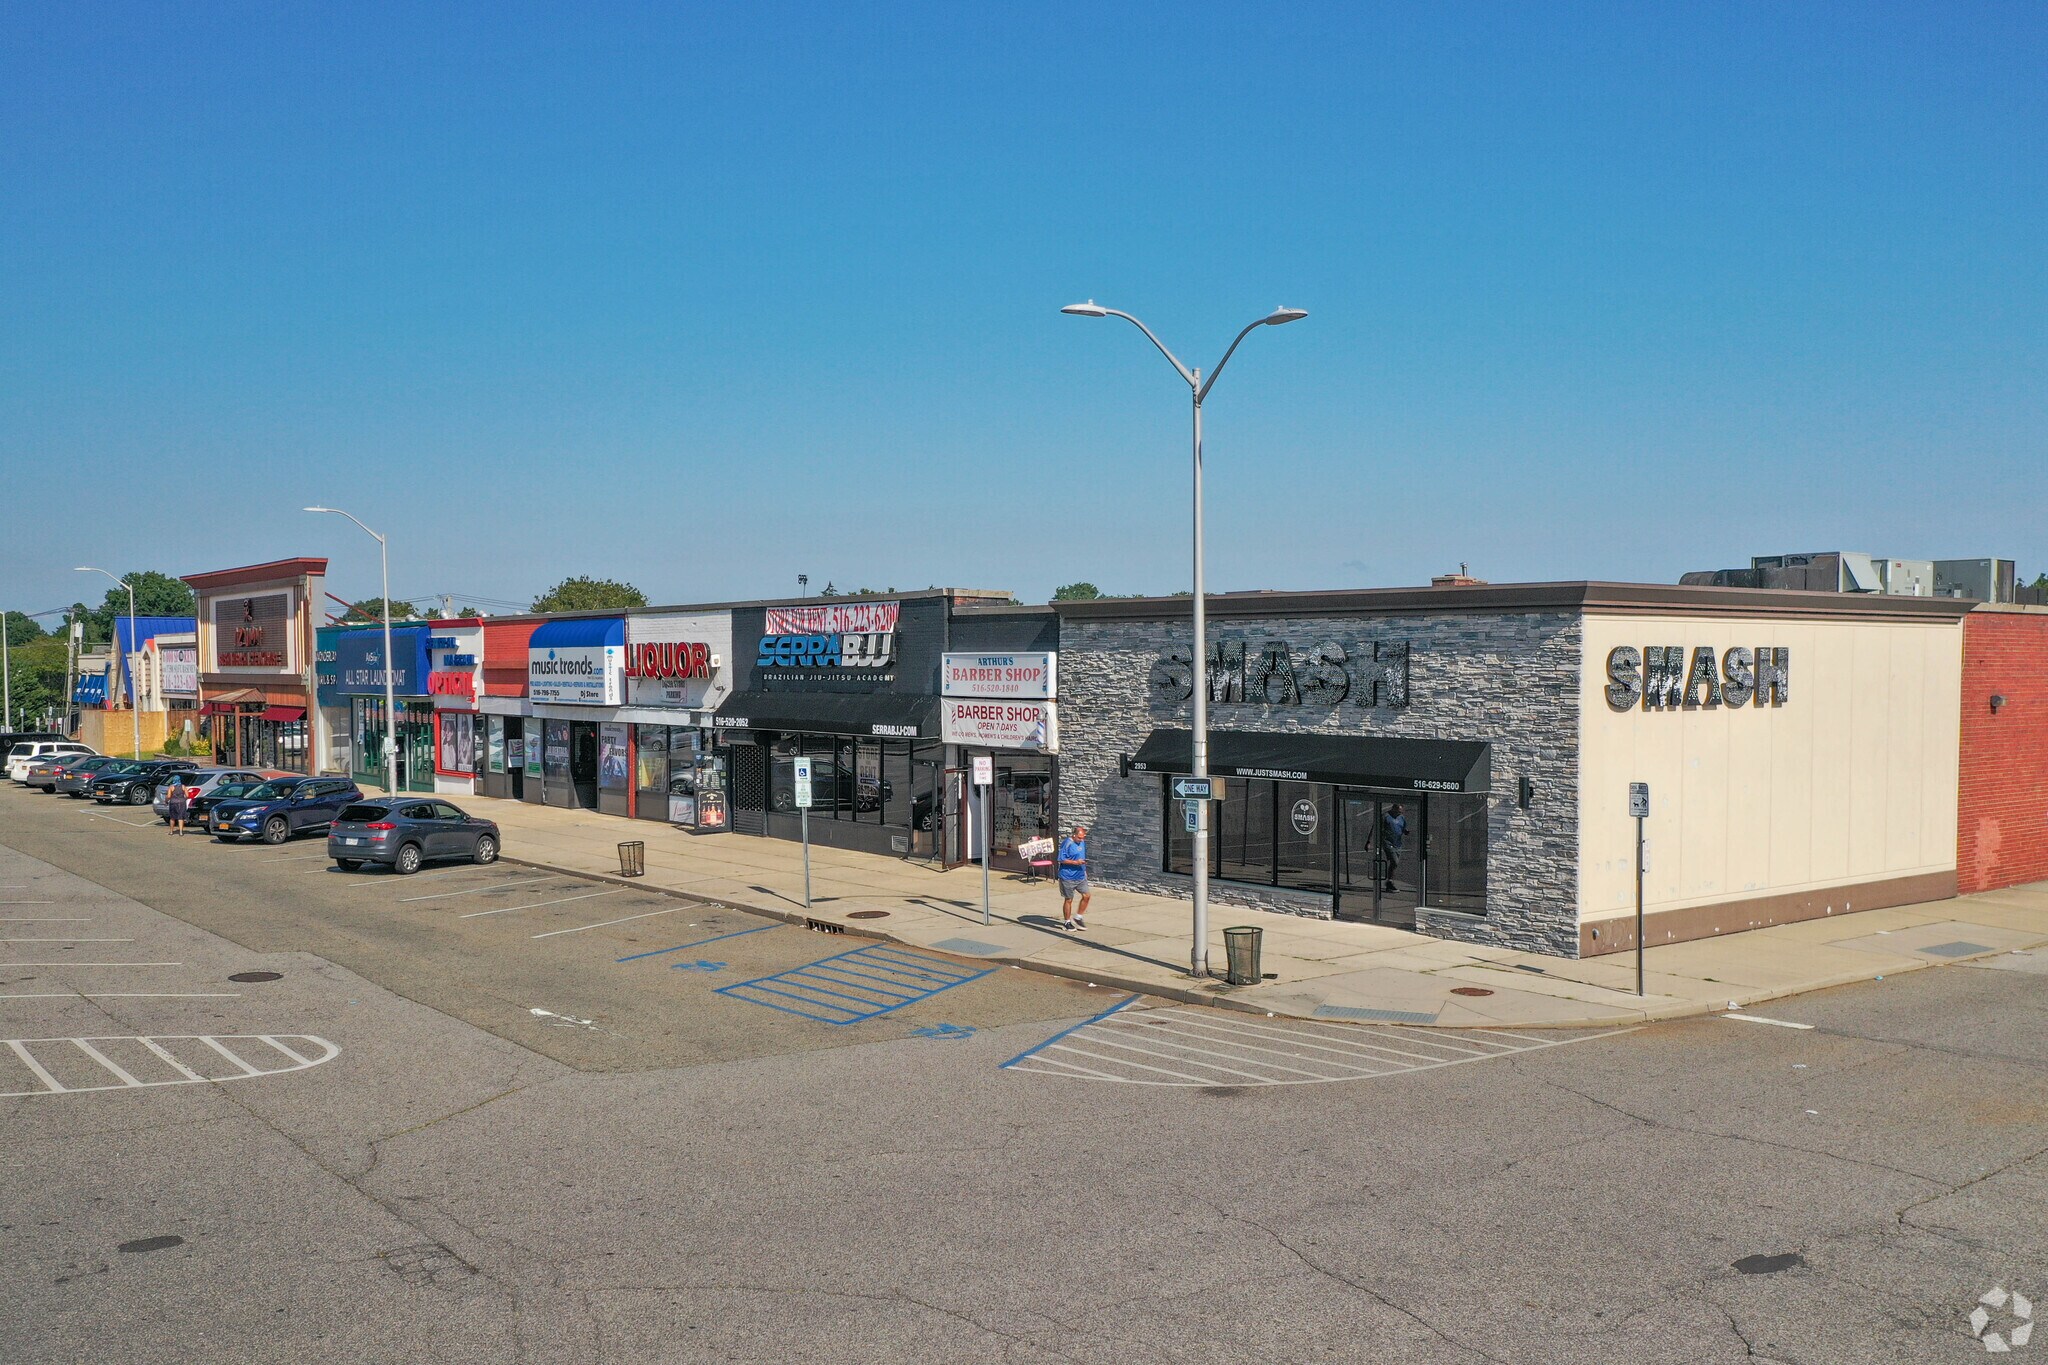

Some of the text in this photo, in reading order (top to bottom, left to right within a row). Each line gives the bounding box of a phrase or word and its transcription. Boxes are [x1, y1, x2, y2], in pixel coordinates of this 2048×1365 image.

[766, 608, 789, 634] STORE
[808, 608, 828, 633] RENT
[532, 660, 558, 675] music
[624, 642, 710, 680] LIQUOR
[345, 669, 406, 686] ALL STAR LAUNDOMAT
[952, 668, 1041, 682] BARBER SHOP
[1152, 641, 1410, 706] SMASH
[1604, 646, 1789, 711] SMASH
[428, 672, 473, 696] OPTICAL
[971, 684, 1019, 692] 516-520-1840
[957, 704, 1040, 722] BARBER SHOP
[977, 722, 995, 731] OPEN
[1000, 723, 1018, 732] DAYS
[601, 735, 617, 744] PARTY
[609, 747, 628, 757] FAVORS
[858, 746, 878, 760] STORE
[860, 766, 876, 778] RENT
[1236, 768, 1307, 780] WWW.JUSTSMASH.COM
[1184, 784, 1207, 793] ONE WAY
[1413, 780, 1460, 790] 516-629-5600
[1294, 813, 1316, 822] SMASH
